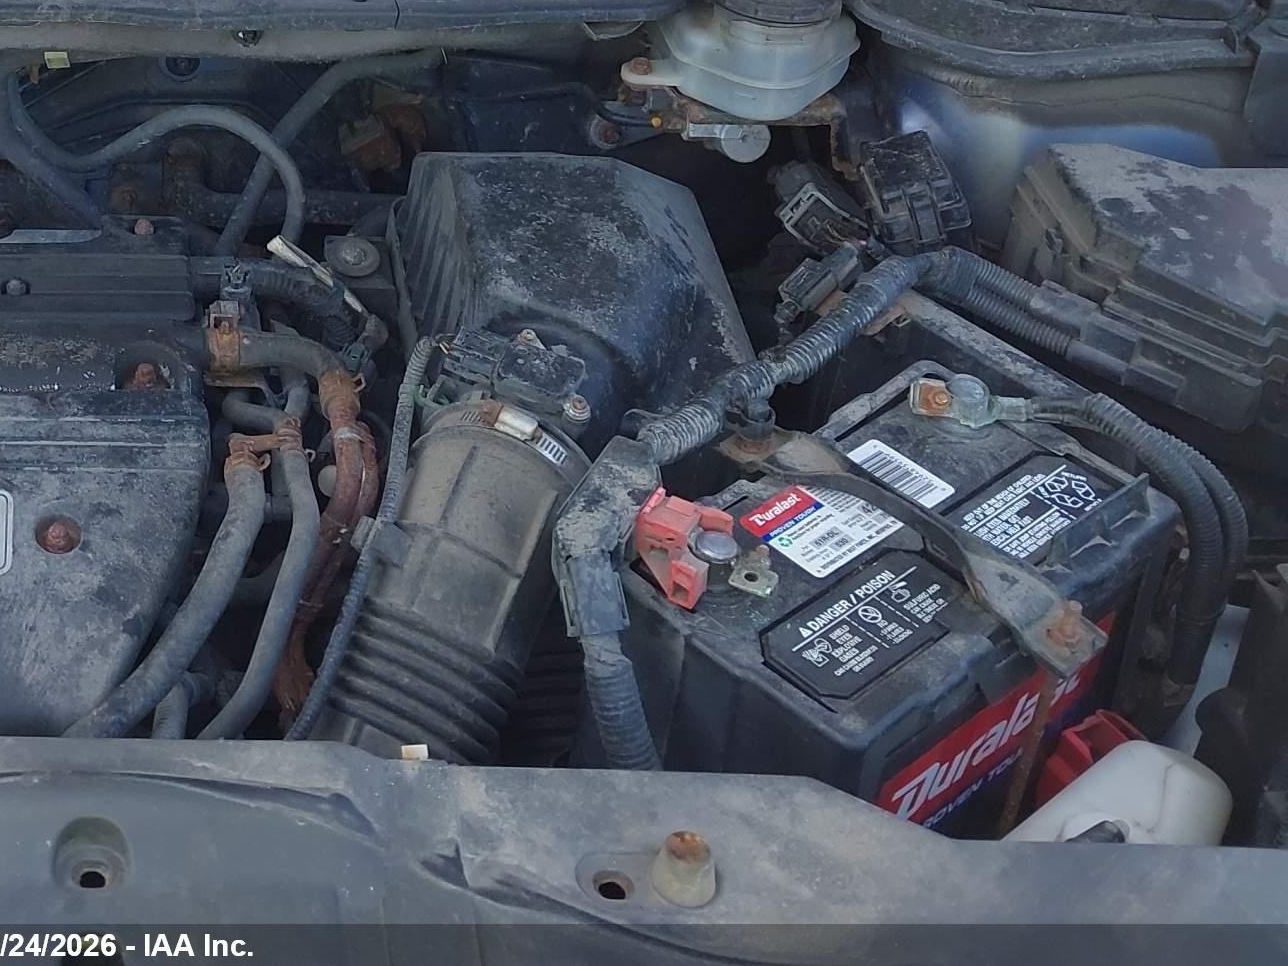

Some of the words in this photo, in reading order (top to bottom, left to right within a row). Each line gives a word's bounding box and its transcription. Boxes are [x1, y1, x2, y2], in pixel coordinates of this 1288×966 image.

[749, 493, 802, 527] Duralast
[769, 520, 794, 538] PROVEN
[794, 505, 817, 522] TOUGH
[807, 599, 853, 631] DANGER
[854, 570, 896, 599] POISON
